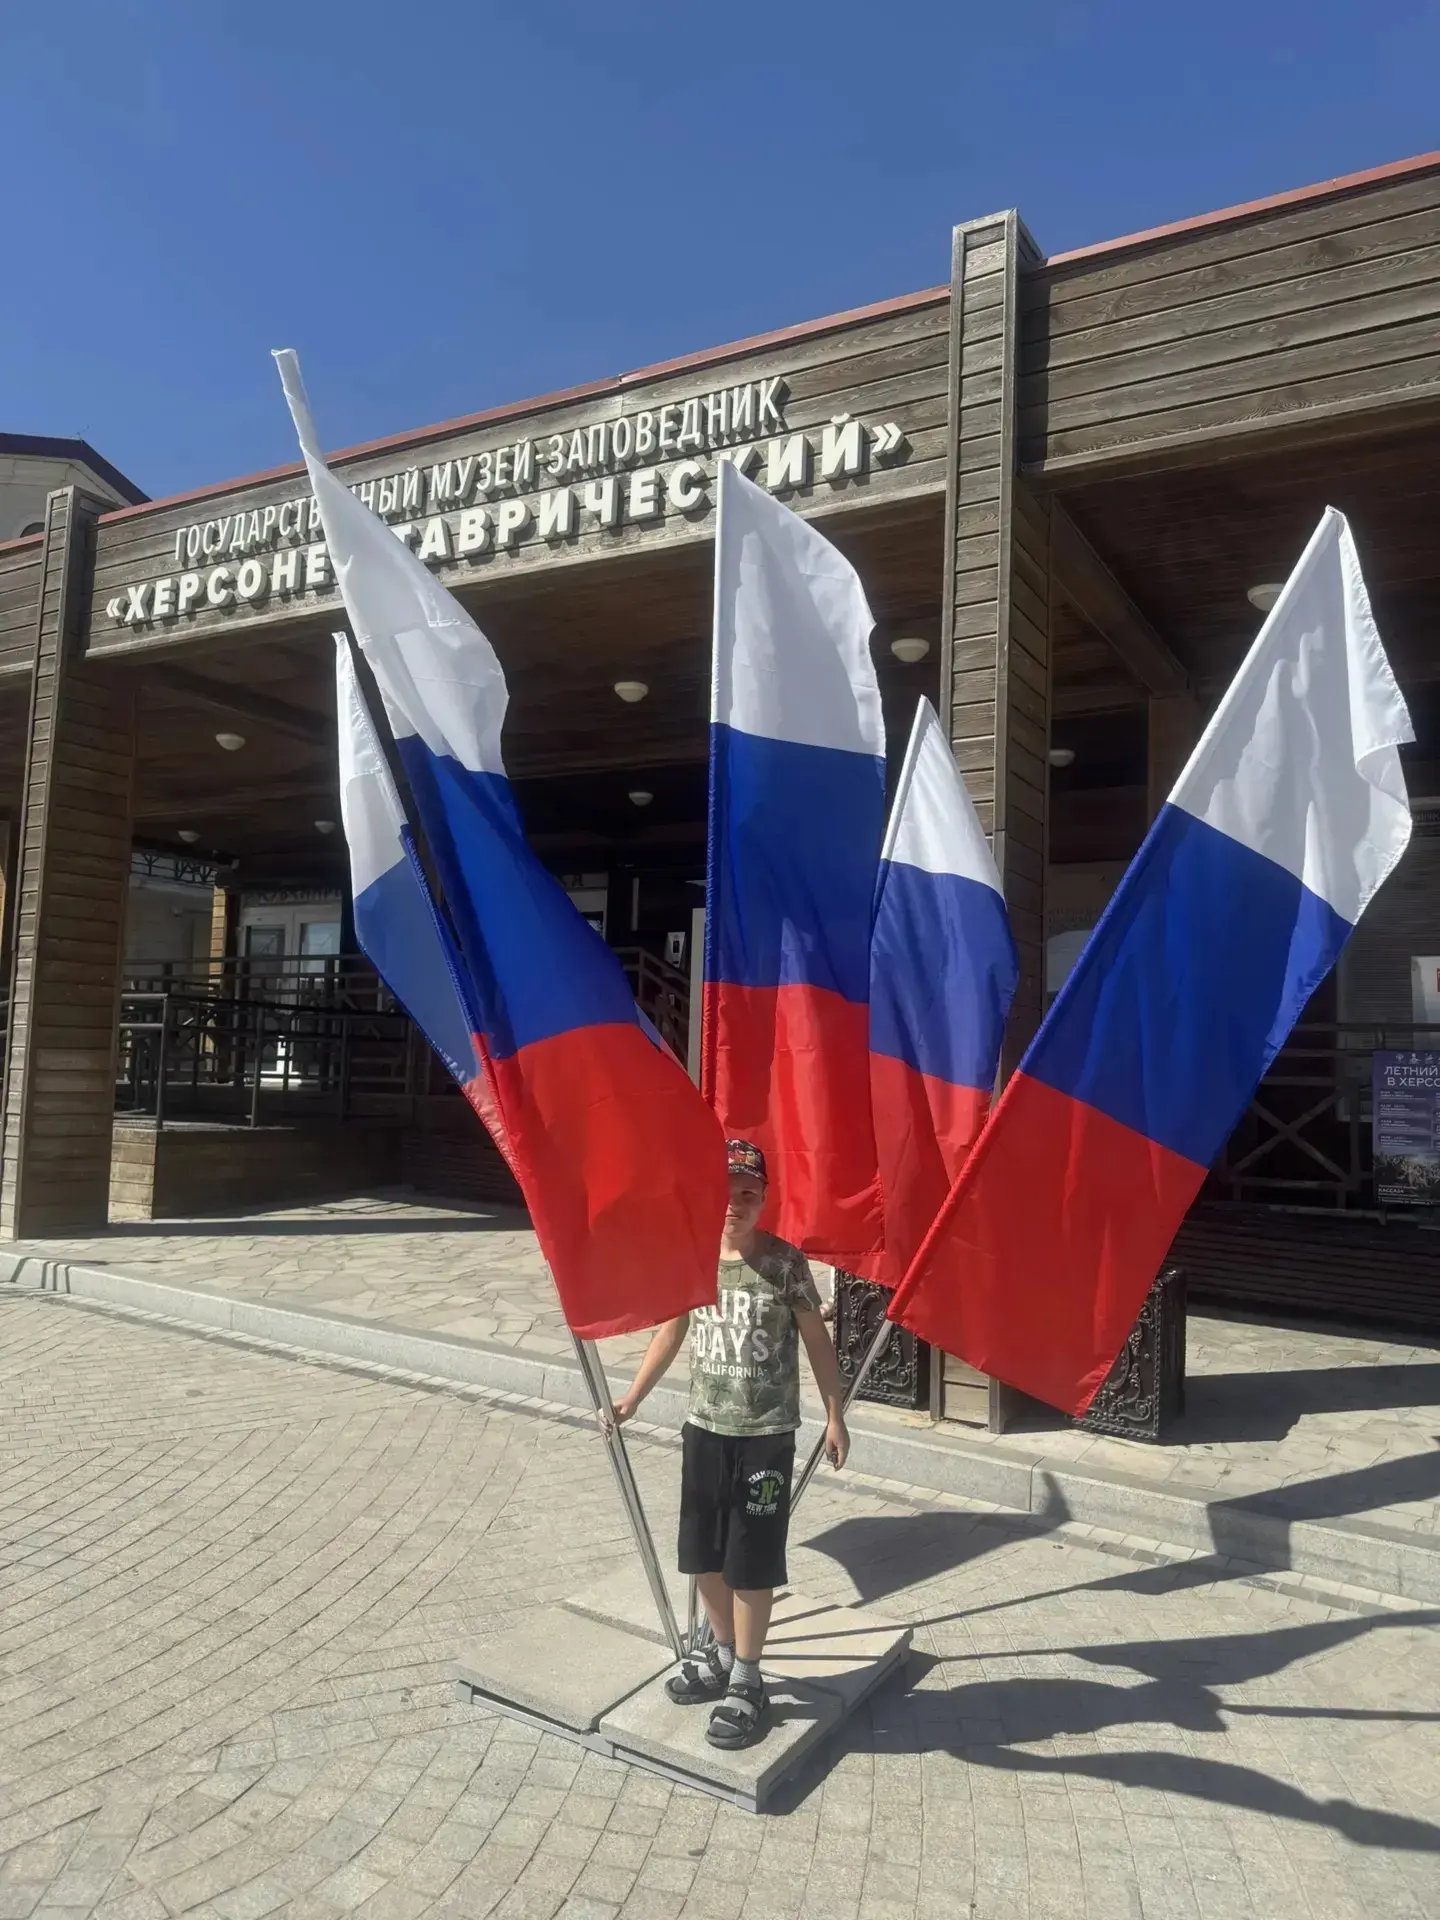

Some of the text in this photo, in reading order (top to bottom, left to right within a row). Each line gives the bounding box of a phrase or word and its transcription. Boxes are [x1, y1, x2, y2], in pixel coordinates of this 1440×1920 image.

[174, 375, 785, 561] ГОСУДАРСТВНЫЙ МУЗЕЙ-ЗАПОВЕДНИК
[105, 542, 331, 623] «ХЕРСОНЕ
[1384, 1065, 1438, 1076] ЛЕТНИЙ
[1387, 1077, 1396, 1086] В
[696, 1323, 769, 1363] DAYS
